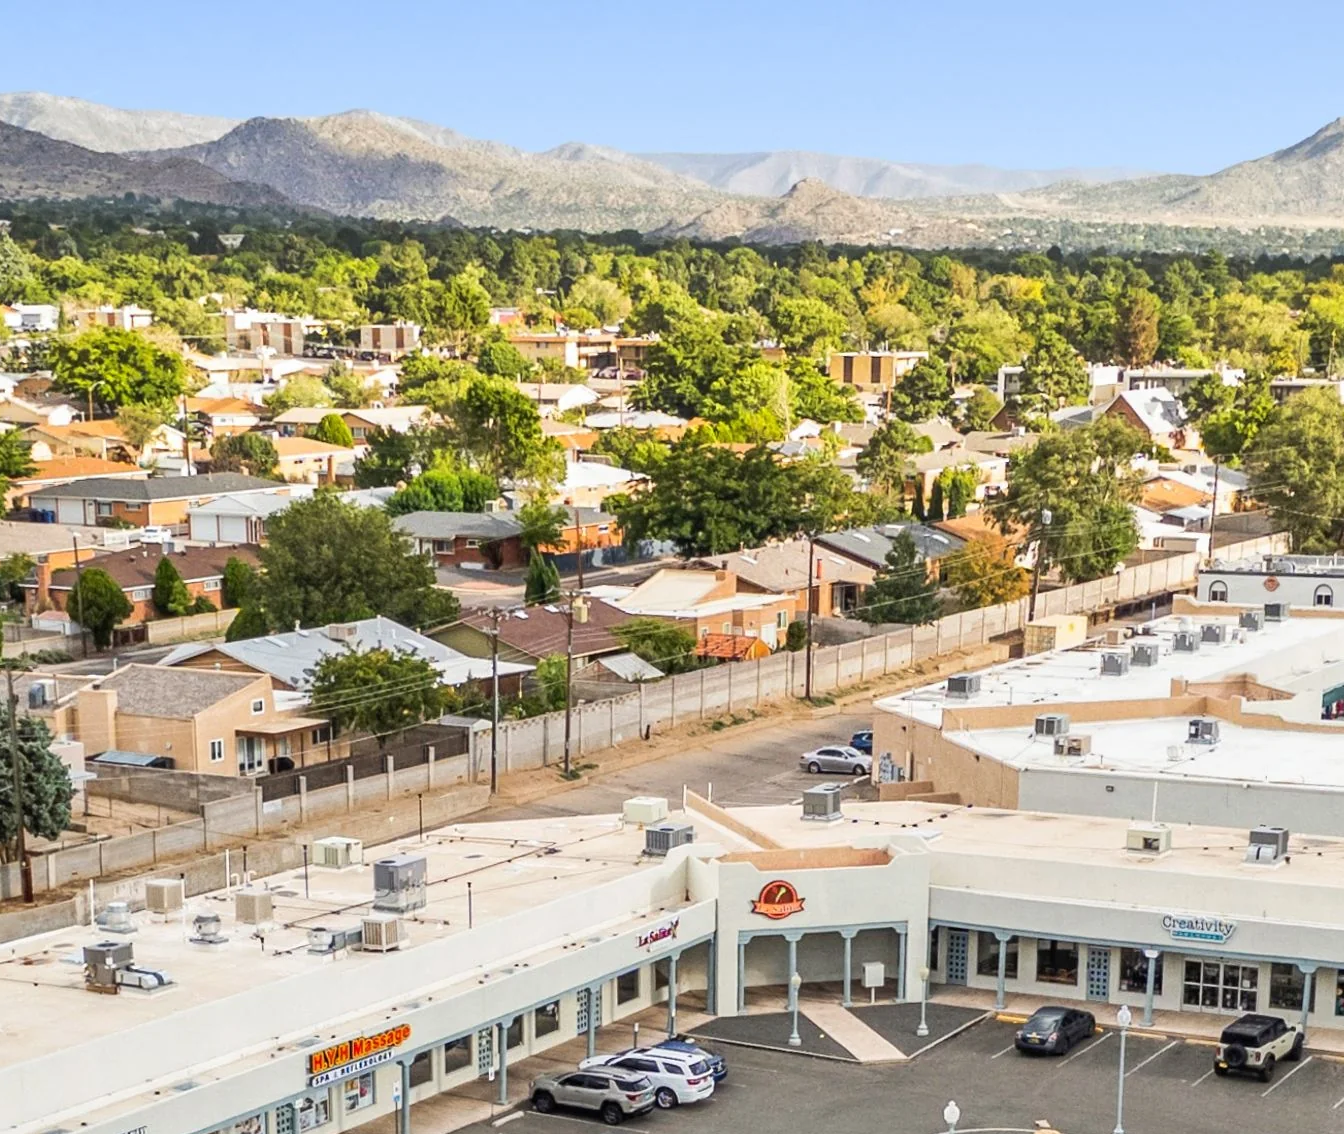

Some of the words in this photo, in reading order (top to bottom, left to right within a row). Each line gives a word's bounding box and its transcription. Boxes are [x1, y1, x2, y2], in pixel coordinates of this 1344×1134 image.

[1162, 915, 1233, 936] Creativity
[352, 1023, 411, 1060] Massage
[314, 1074, 330, 1086] SPA
[340, 1050, 393, 1076] REFLEXOLOGY
